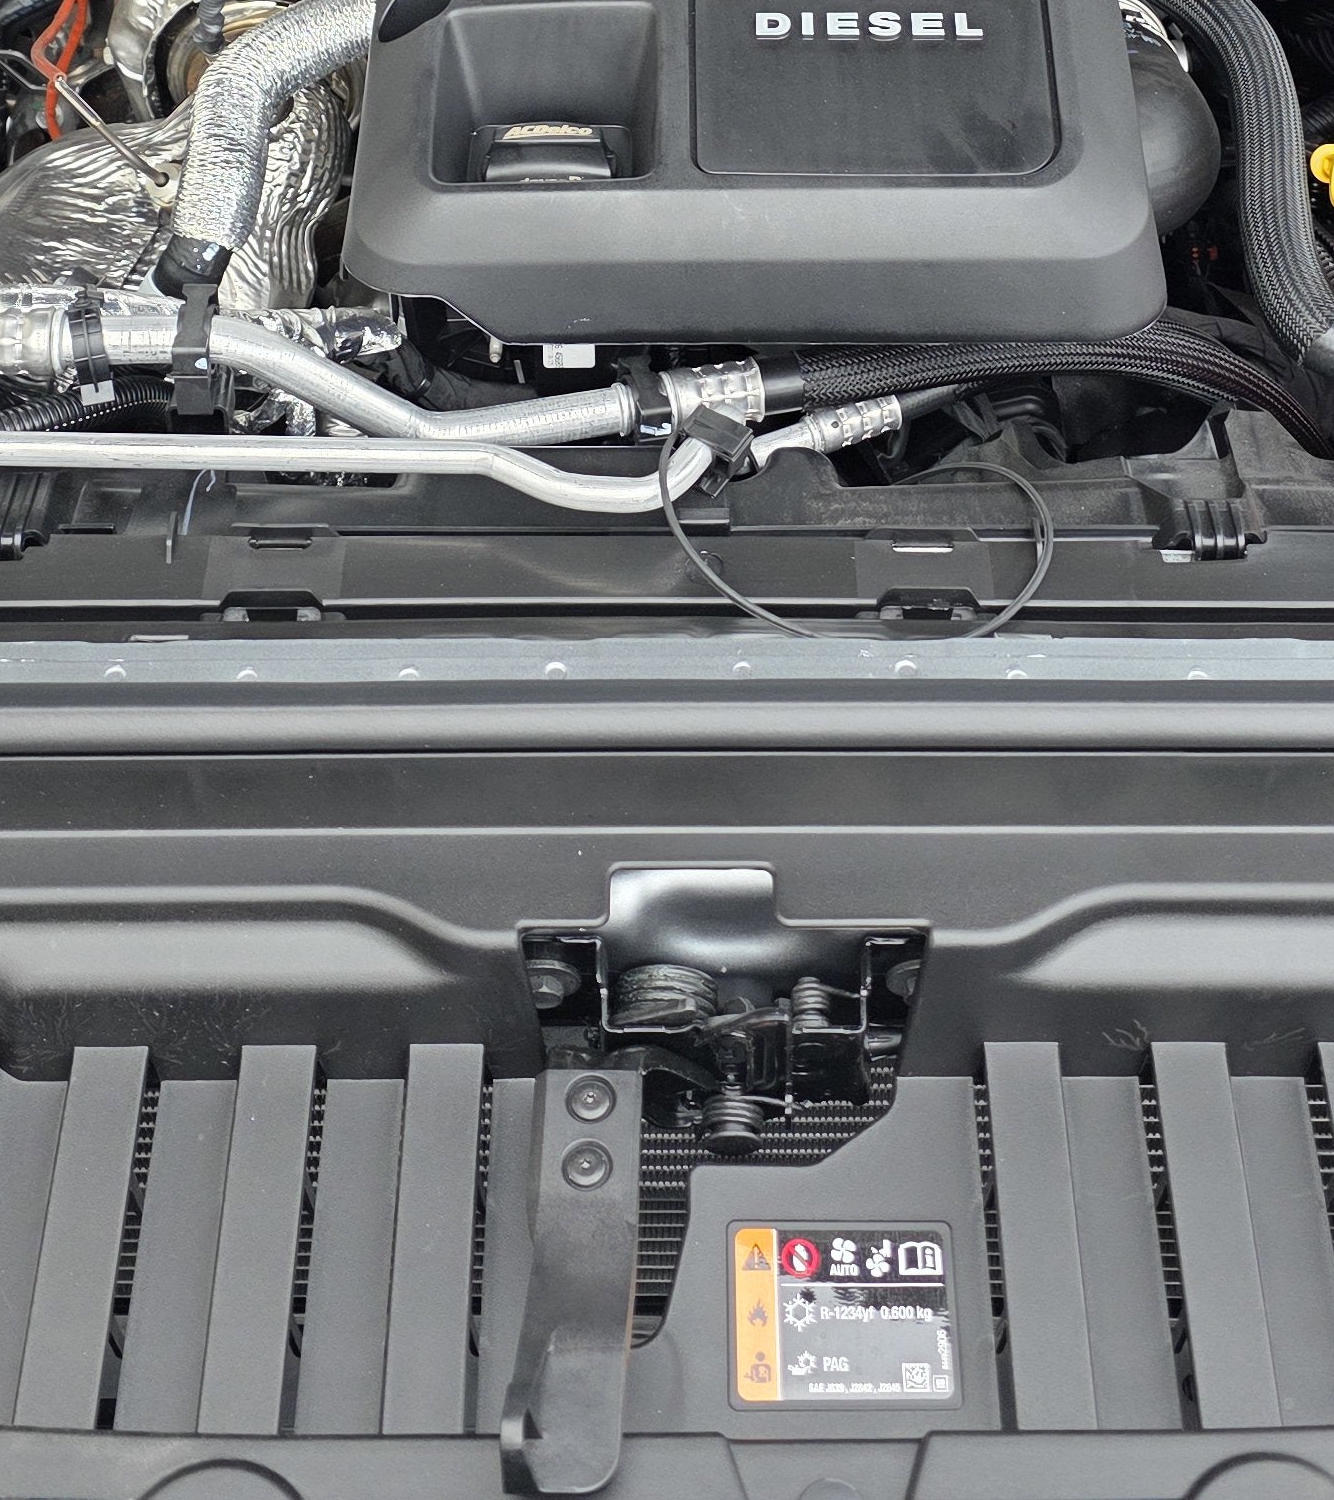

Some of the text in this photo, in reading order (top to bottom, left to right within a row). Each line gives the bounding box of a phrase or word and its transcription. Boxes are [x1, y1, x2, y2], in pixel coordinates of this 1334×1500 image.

[755, 11, 984, 40] DIESEL
[502, 125, 593, 140] ACDelco
[829, 1263, 860, 1276] AUTO
[820, 1305, 934, 1323] R-1234yf 0.600 kg
[822, 1356, 850, 1372] PAG
